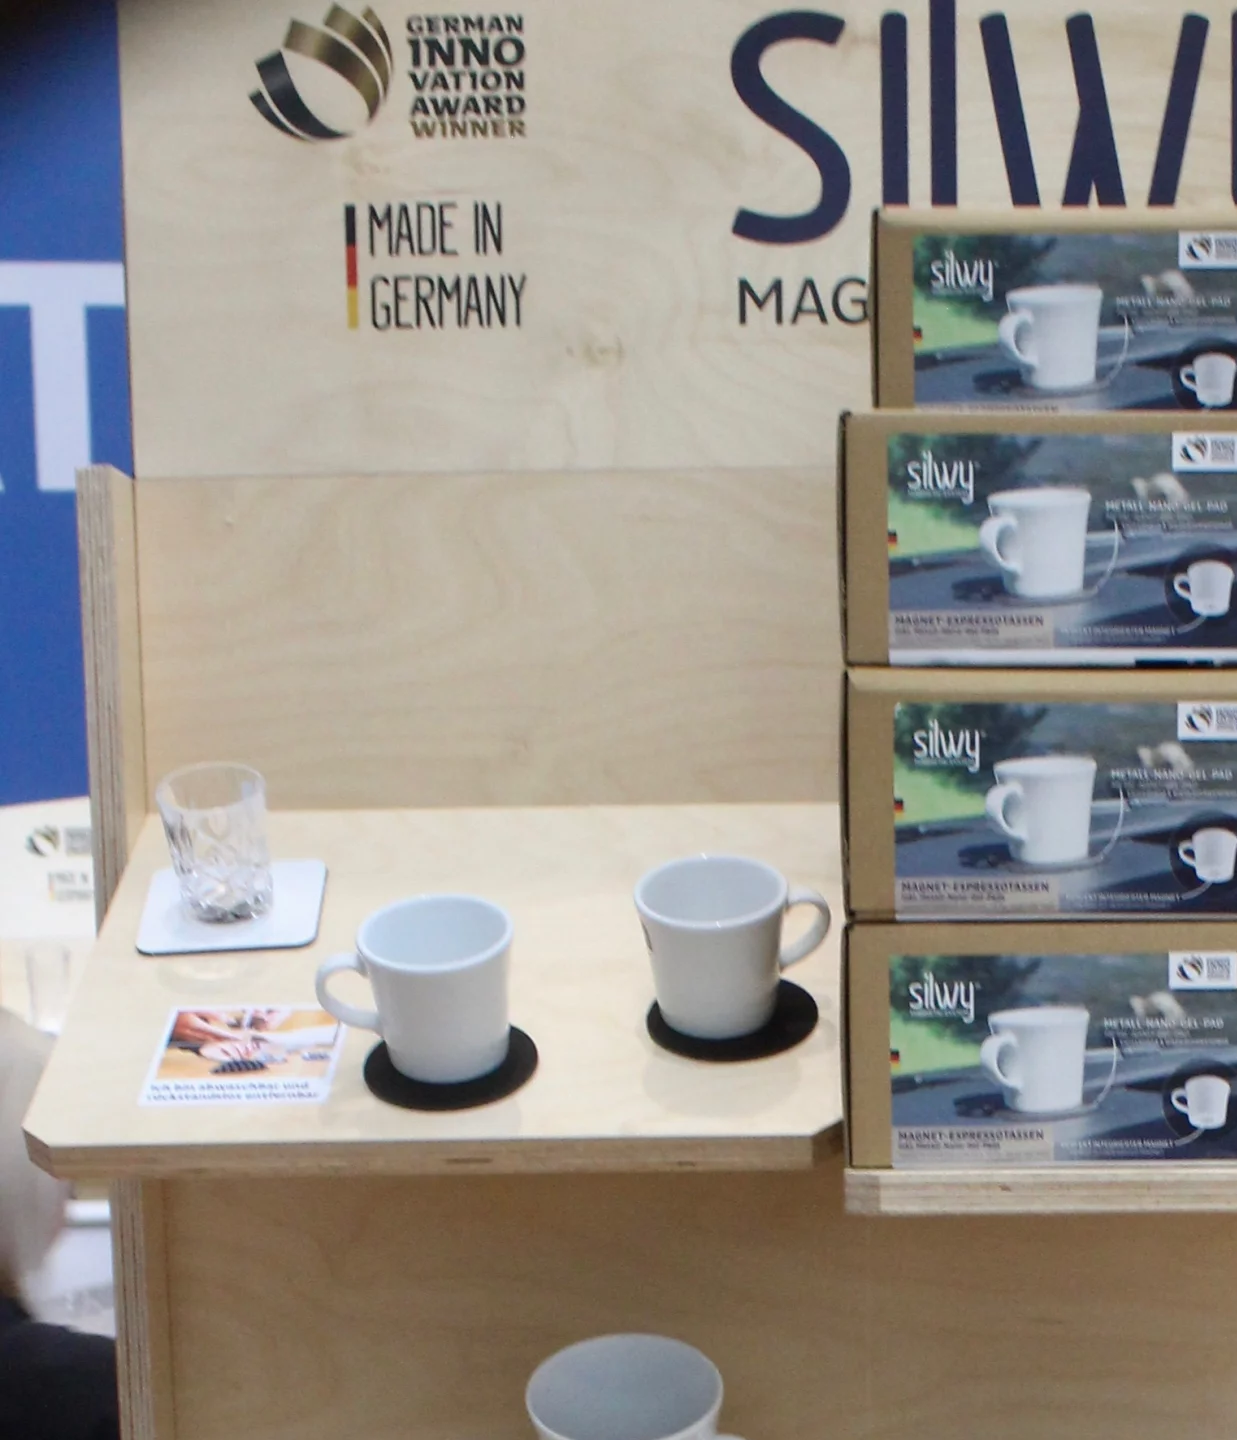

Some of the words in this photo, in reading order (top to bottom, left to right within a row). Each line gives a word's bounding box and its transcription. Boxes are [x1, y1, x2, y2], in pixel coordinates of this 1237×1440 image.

[406, 14, 523, 34] GERMAN
[407, 37, 525, 67] INNO
[408, 69, 525, 92] VATION
[411, 95, 526, 117] AWARD
[411, 119, 526, 138] WINNER
[368, 202, 457, 257] MADE
[474, 202, 502, 256] IN
[738, 276, 868, 326] MAG
[931, 249, 994, 302] silwy
[370, 274, 527, 330] GERMANY
[0, 261, 126, 491] T
[907, 451, 976, 504] silwy
[913, 720, 981, 772] silwy
[908, 971, 976, 1023] silwy
